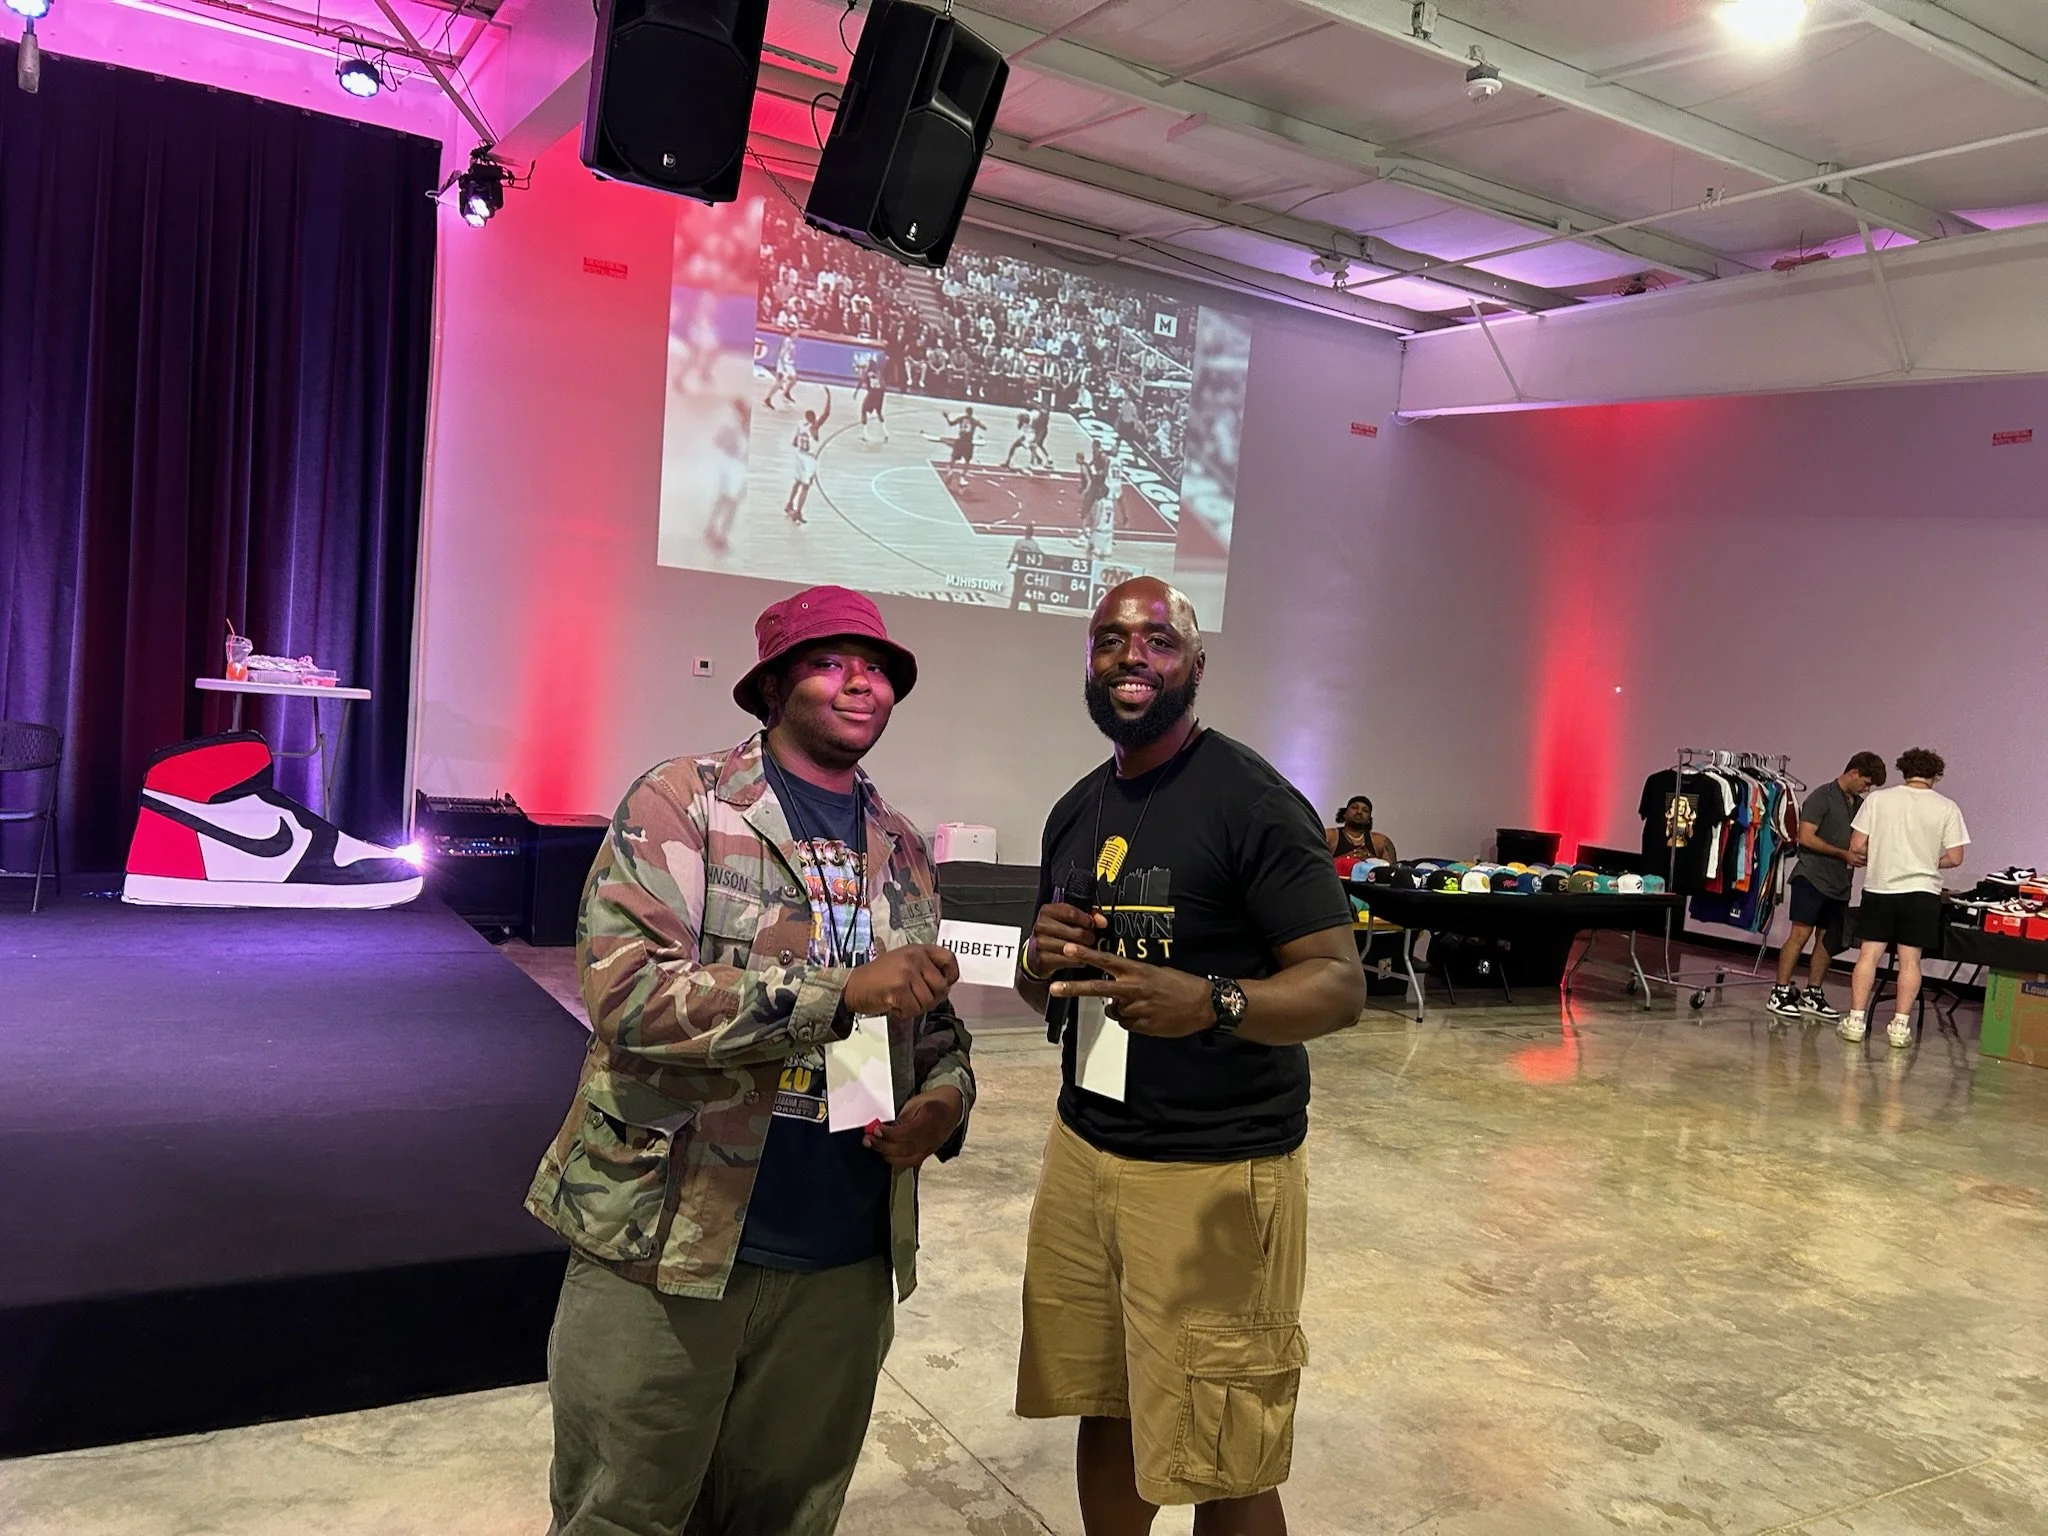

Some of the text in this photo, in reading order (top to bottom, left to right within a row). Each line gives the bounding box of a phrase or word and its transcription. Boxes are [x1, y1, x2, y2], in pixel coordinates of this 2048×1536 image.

[1025, 553, 1089, 573] NJ 83
[945, 575, 1003, 593] MJHISTORY
[1023, 573, 1087, 592] CHI 84
[1024, 590, 1046, 602] 4th
[941, 938, 1016, 959] HIBBETT
